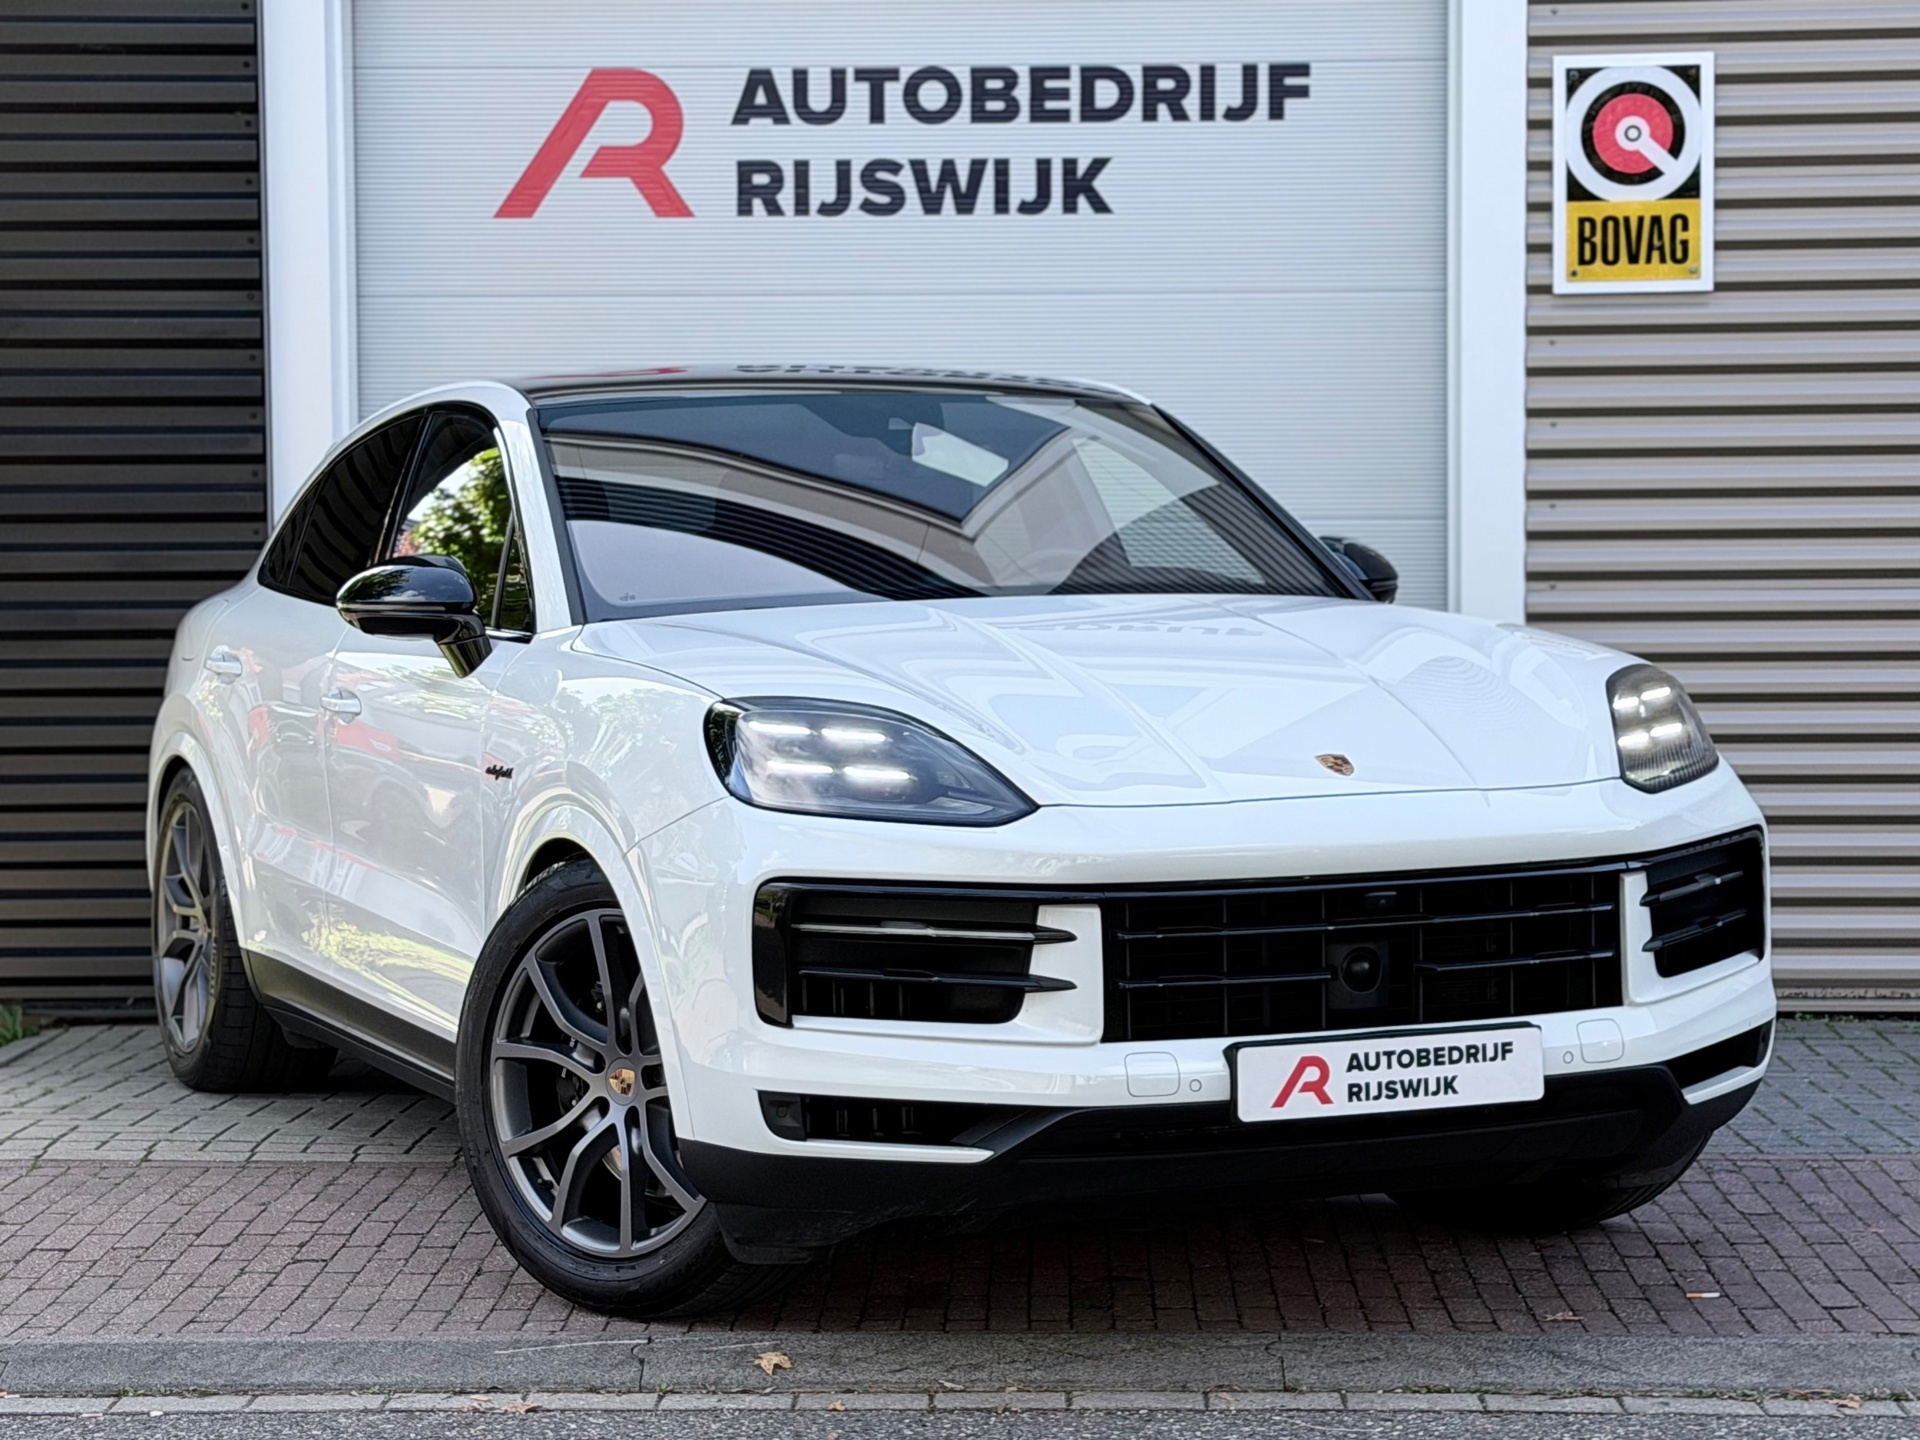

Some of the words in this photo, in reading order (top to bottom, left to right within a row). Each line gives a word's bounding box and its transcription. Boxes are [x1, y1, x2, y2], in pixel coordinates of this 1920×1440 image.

[732, 63, 1311, 125] AUTOBEDRIJF
[737, 158, 1113, 217] RIJSWIJK
[1578, 214, 1690, 266] BOVAG
[1346, 1041, 1513, 1073] AUTOBEDRIJF
[1347, 1075, 1459, 1103] RIJSWIJK
